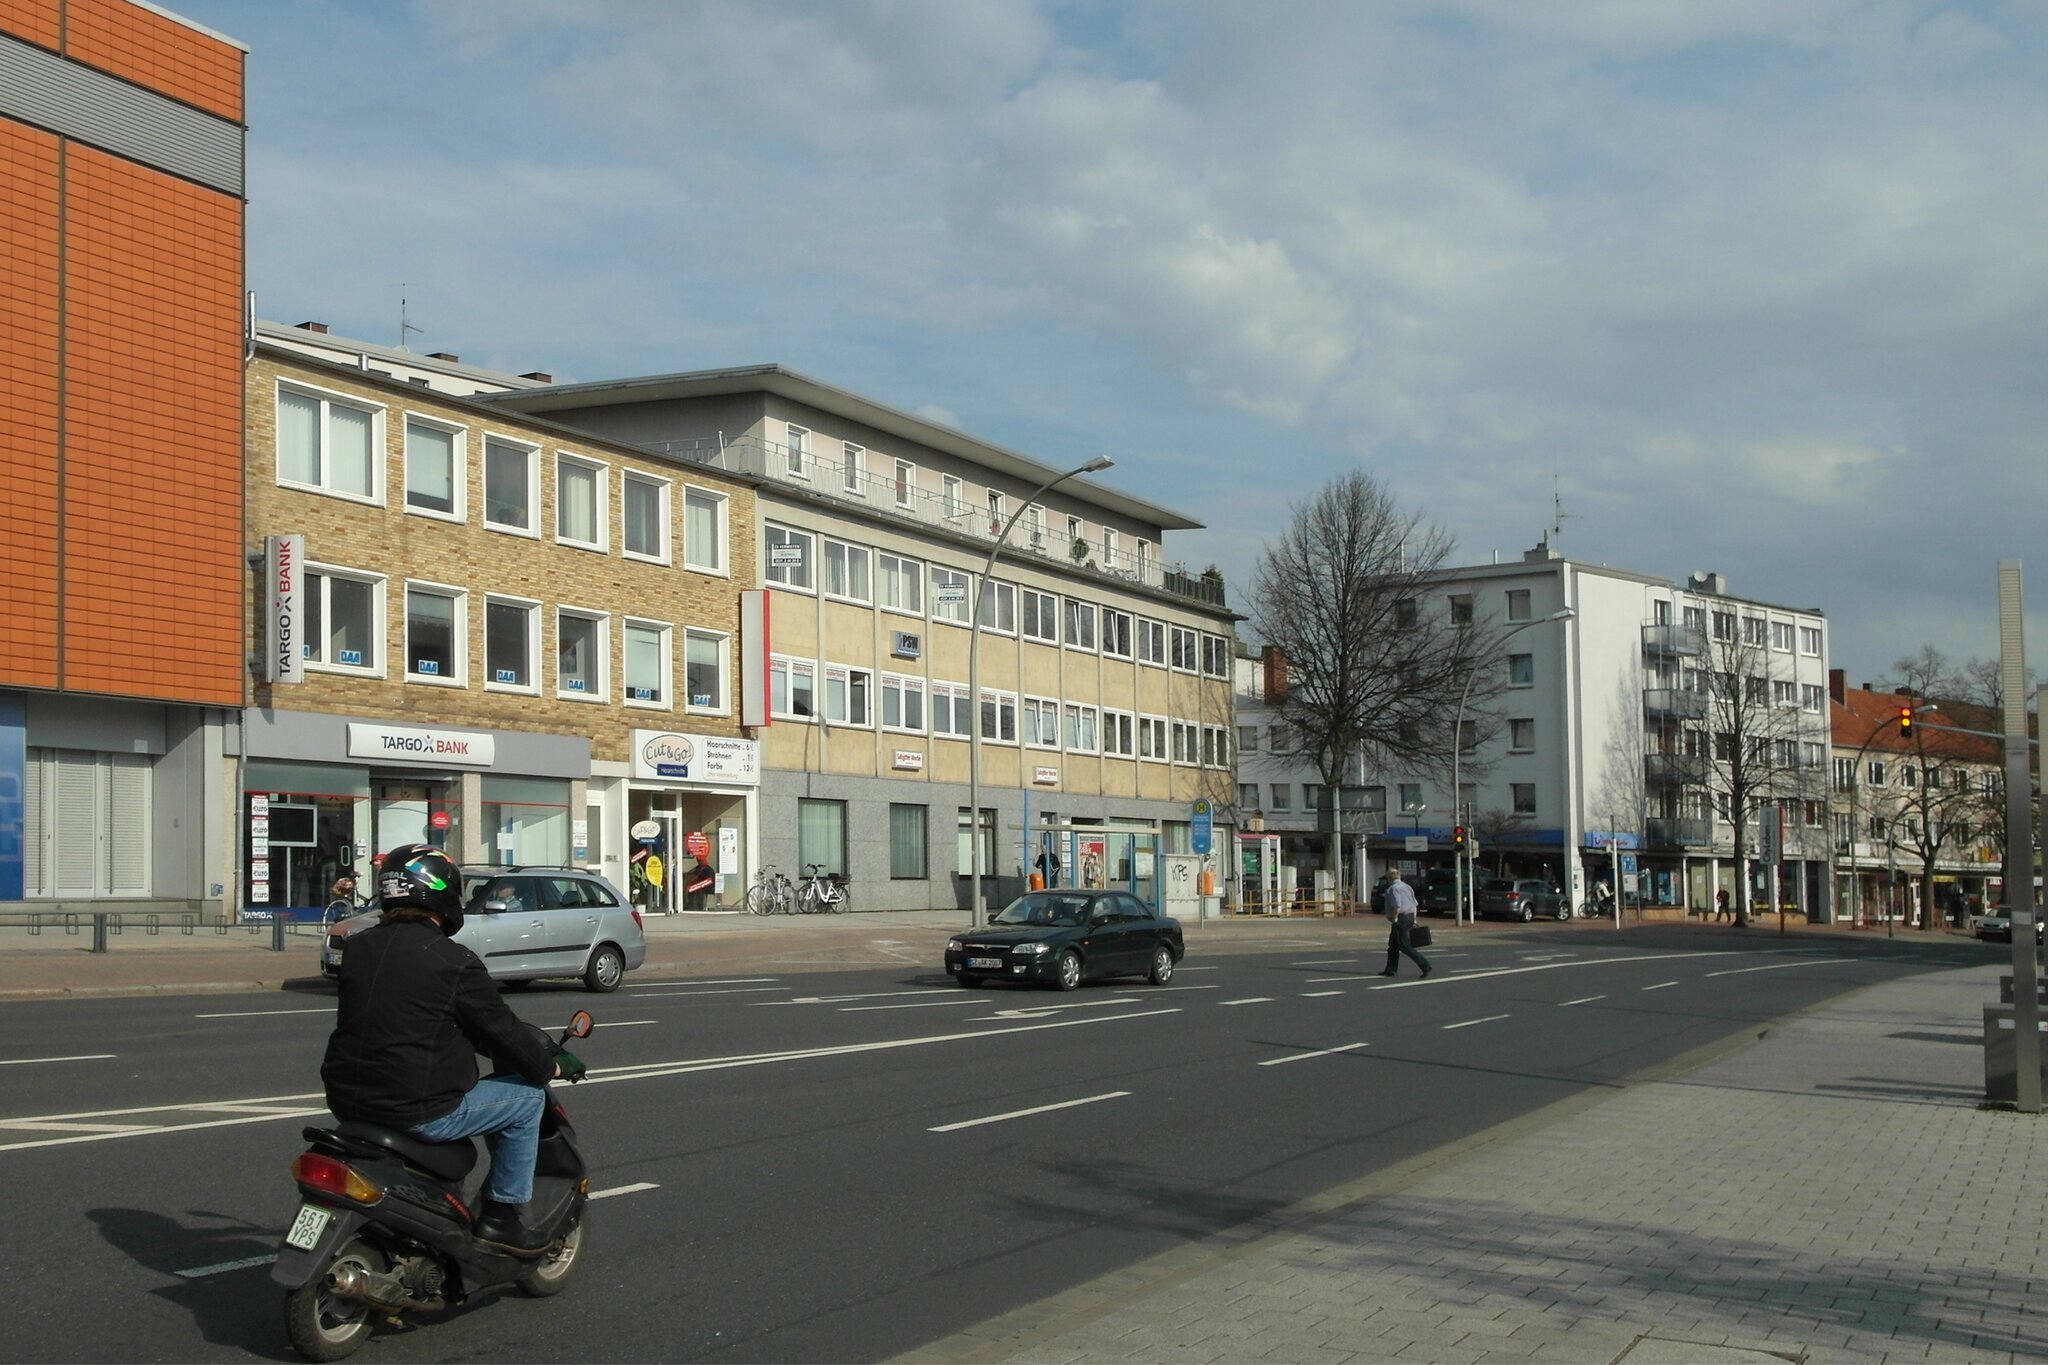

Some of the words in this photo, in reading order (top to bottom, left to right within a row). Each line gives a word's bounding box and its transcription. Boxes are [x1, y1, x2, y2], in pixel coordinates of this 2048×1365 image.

[279, 541, 291, 592] BANK
[279, 615, 291, 677] TARGO
[902, 634, 919, 650] PSW
[341, 651, 360, 663] DAA
[419, 661, 437, 673] DAA
[497, 670, 514, 682] DAA
[568, 679, 584, 690] DAA
[636, 688, 650, 699] DAA
[381, 736, 422, 751] TARGO
[436, 740, 469, 754] BANK
[298, 1208, 325, 1230] 561
[291, 1225, 316, 1246] YPS
